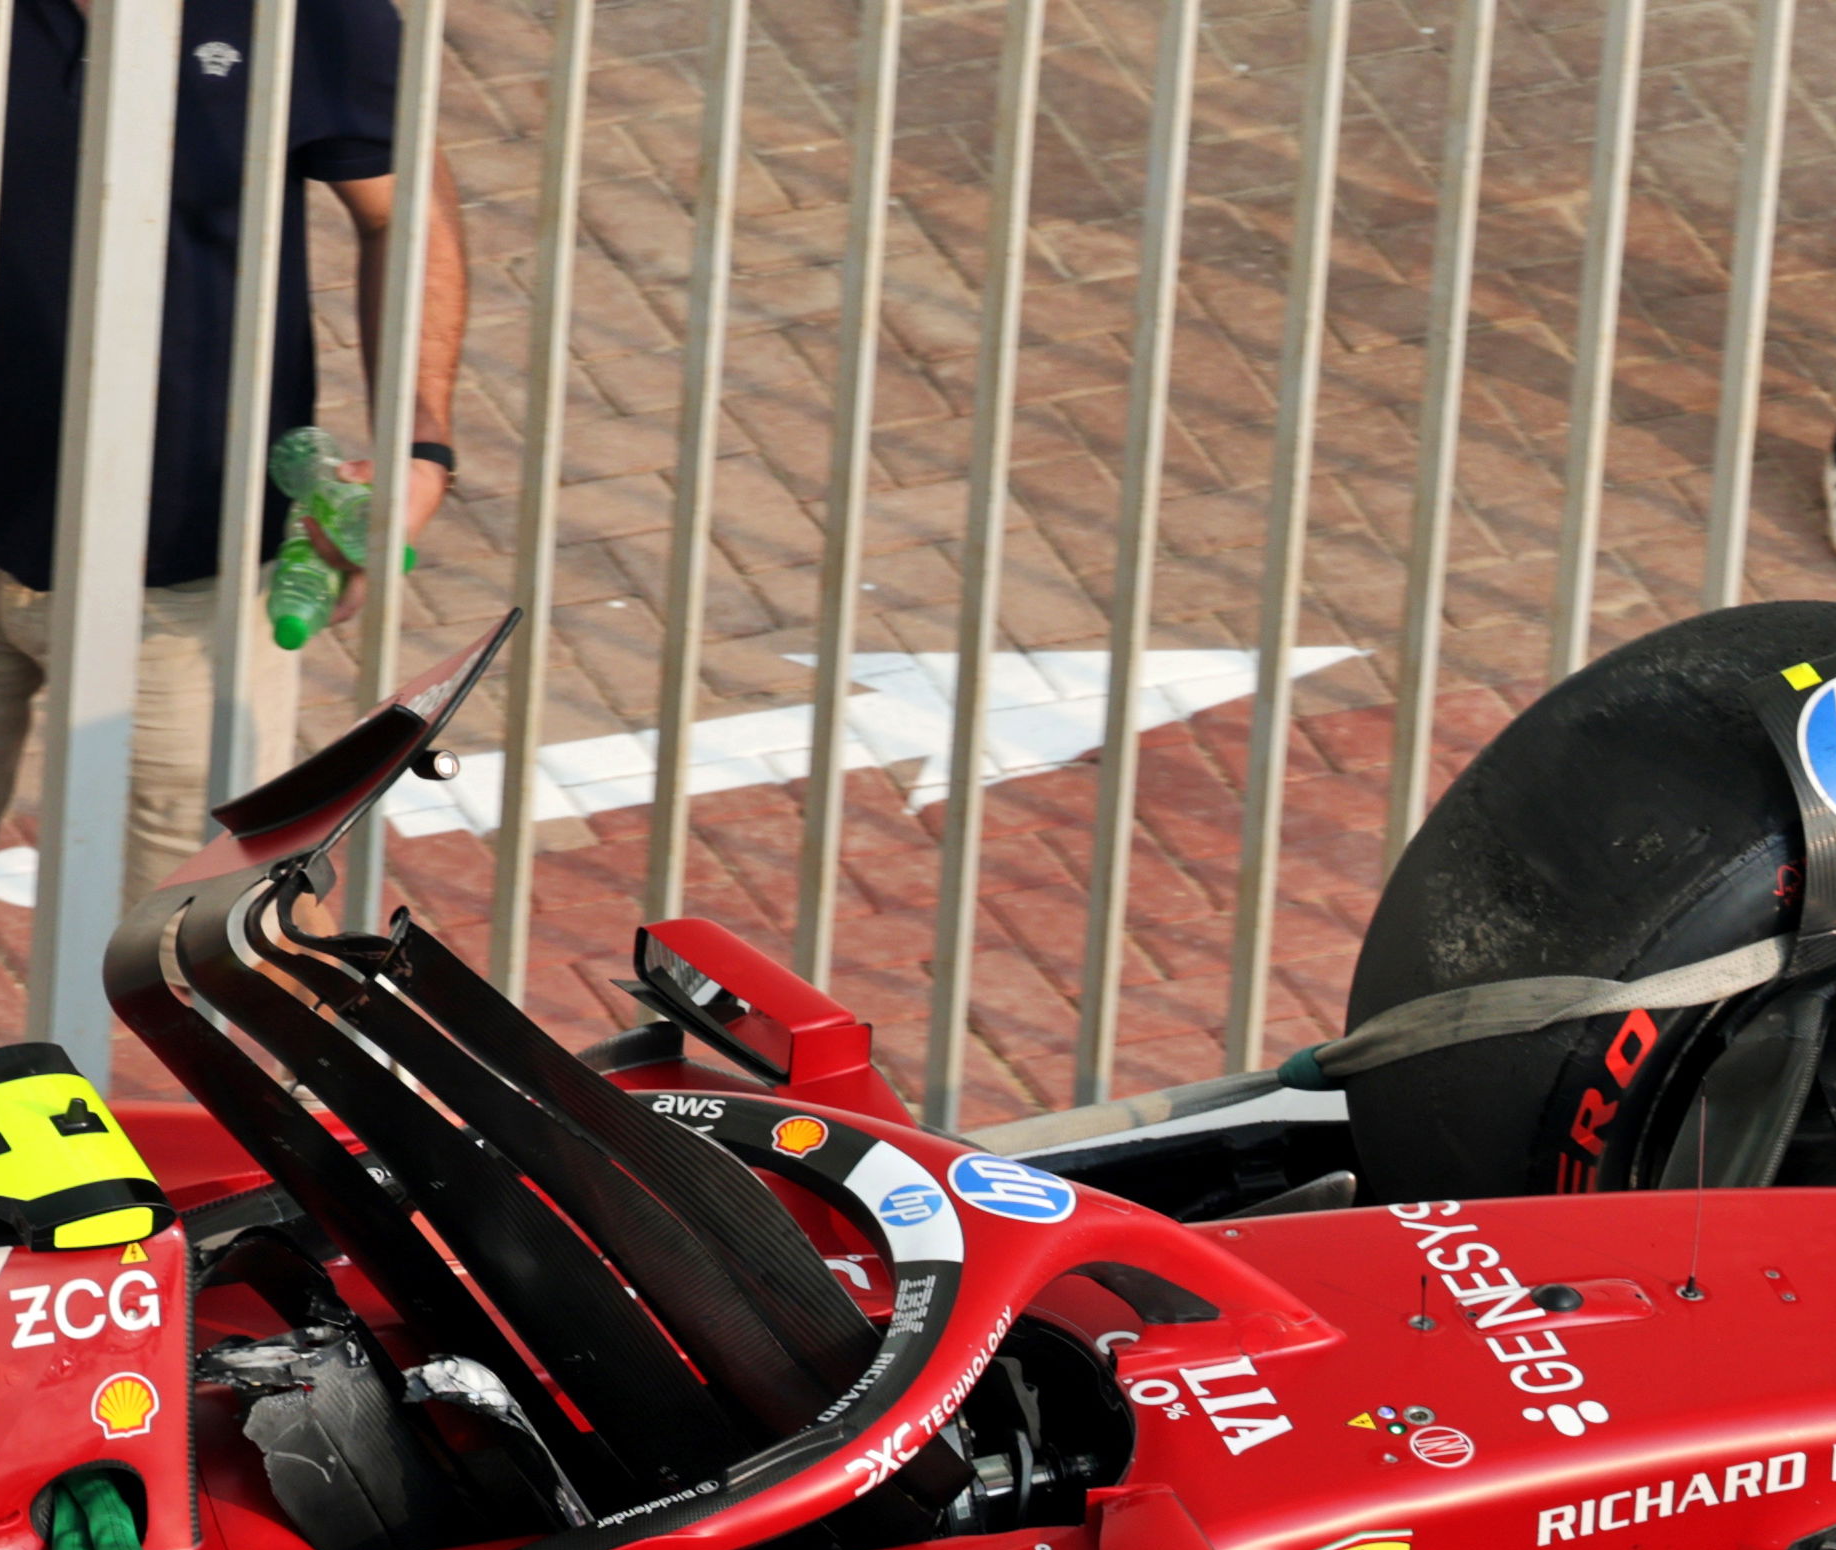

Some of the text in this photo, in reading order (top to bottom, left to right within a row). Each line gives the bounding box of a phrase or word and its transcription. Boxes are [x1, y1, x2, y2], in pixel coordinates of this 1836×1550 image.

[652, 1094, 726, 1119] aws
[959, 1158, 1069, 1215] hp
[887, 1275, 936, 1338] IBM
[817, 1353, 895, 1422] RICHARD
[844, 1305, 1013, 1497] DXC TECHNOLOGY
[1178, 1355, 1294, 1456] LIA
[1537, 1452, 1806, 1546] RICHARD
